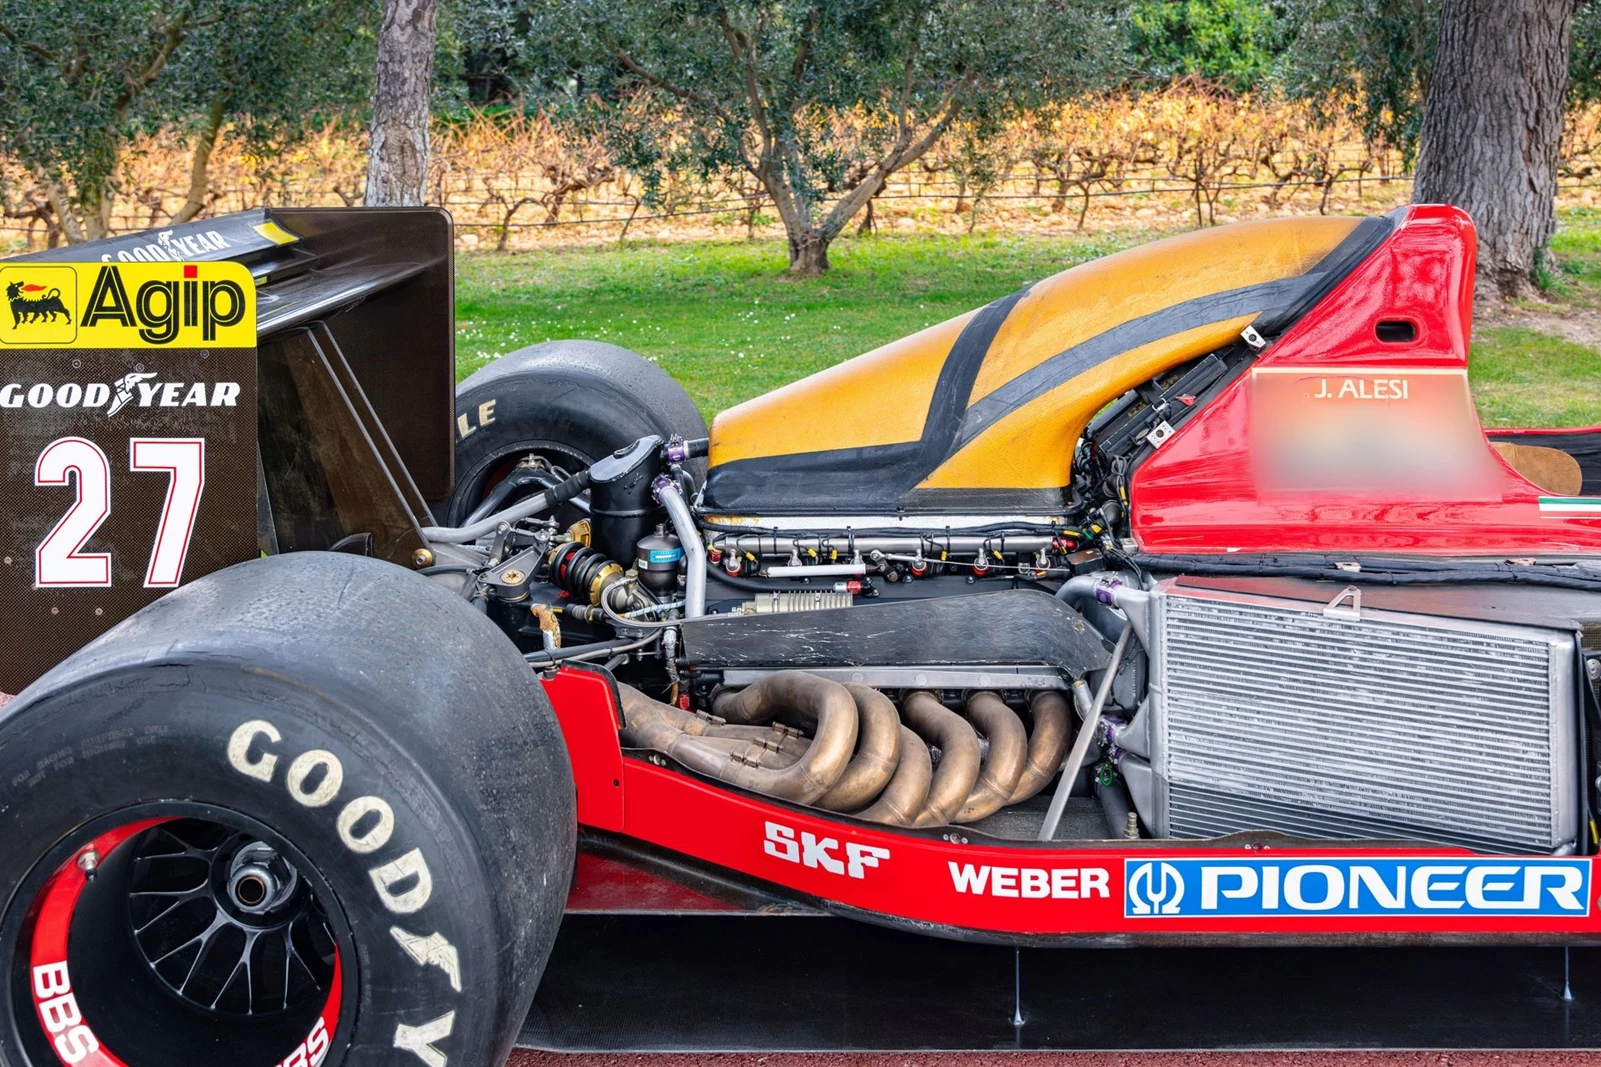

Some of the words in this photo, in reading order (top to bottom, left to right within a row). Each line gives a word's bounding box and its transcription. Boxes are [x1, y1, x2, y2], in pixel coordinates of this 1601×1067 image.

[80, 265, 246, 344] Agip
[1314, 378, 1332, 398] J.
[1338, 379, 1408, 399] ALESI
[34, 436, 205, 587] 27
[763, 821, 890, 879] SKF
[948, 861, 1110, 899] WEBER
[1200, 865, 1585, 911] PIONEER
[33, 960, 99, 1063] BBS
